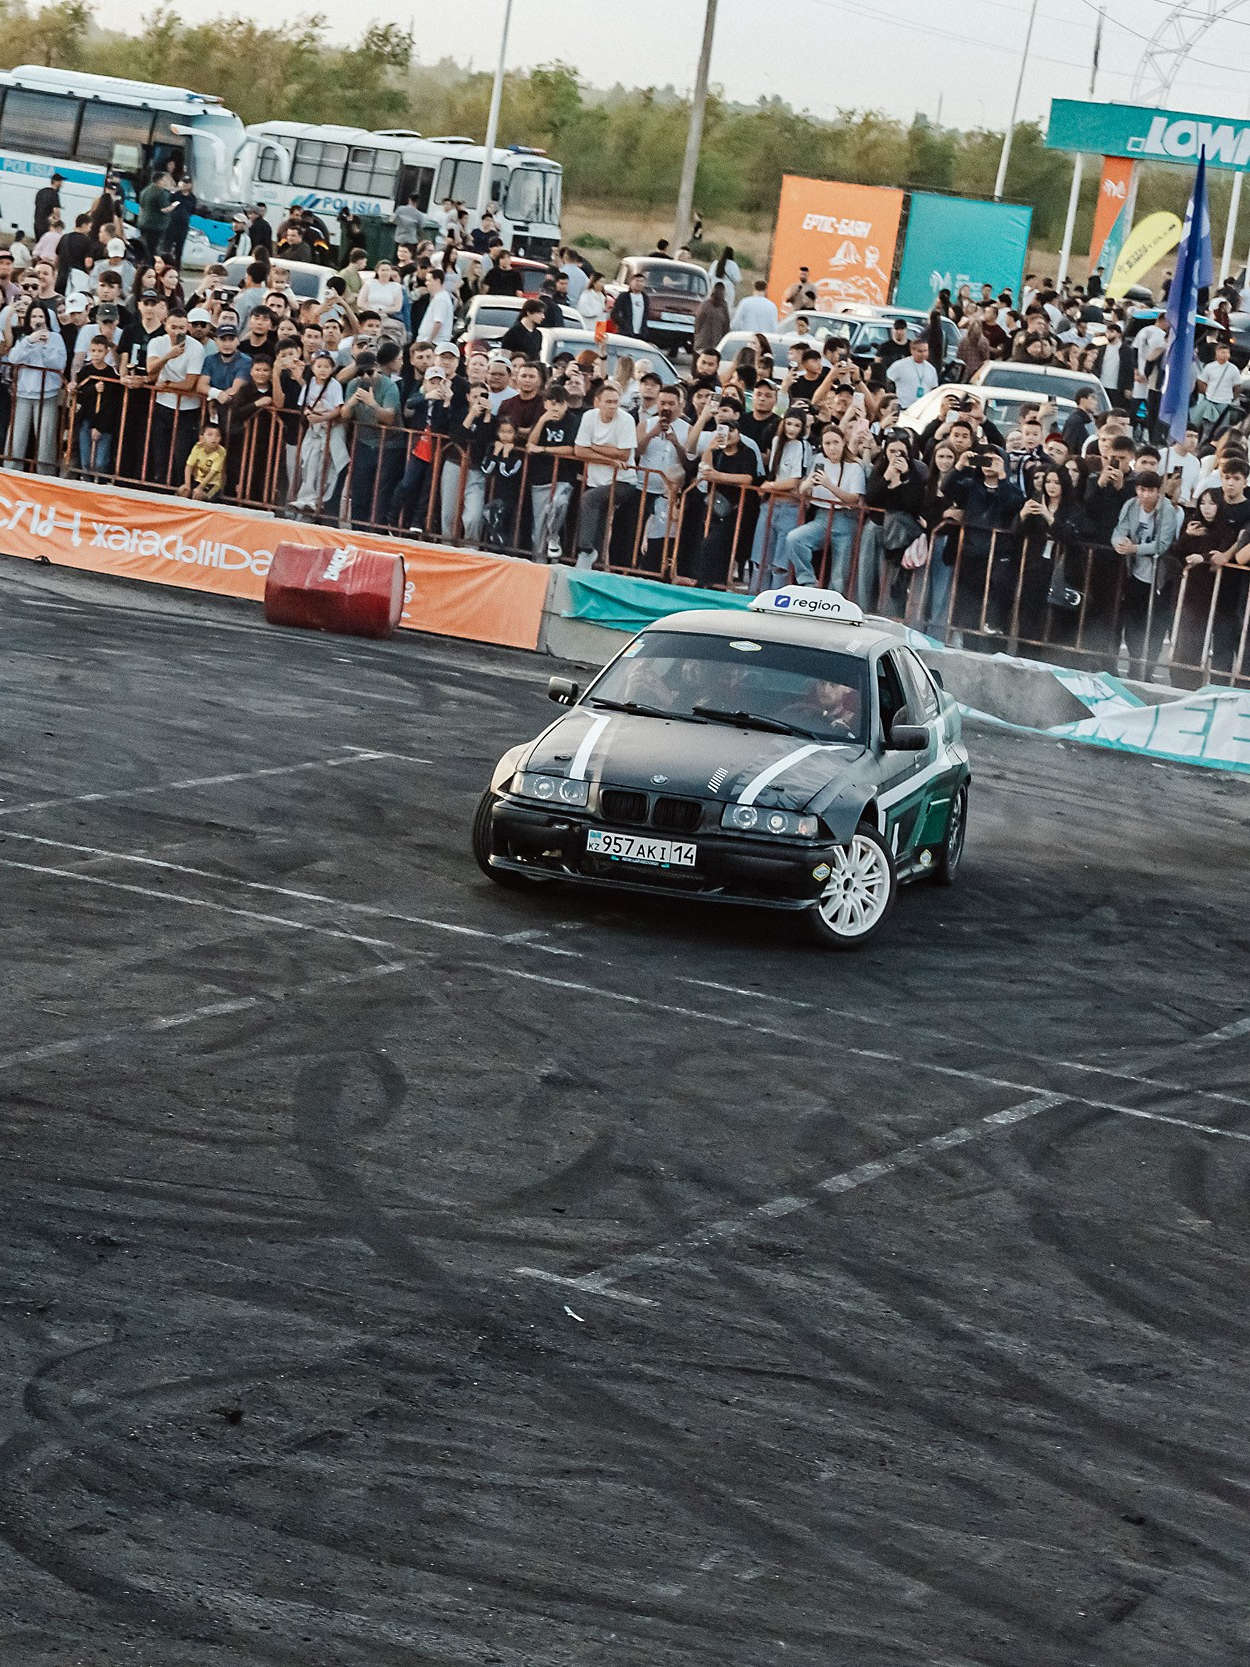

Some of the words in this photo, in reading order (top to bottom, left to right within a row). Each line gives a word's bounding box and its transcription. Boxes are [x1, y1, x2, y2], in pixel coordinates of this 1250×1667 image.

[323, 196, 382, 215] POLISIA
[792, 598, 841, 613] region
[588, 842, 600, 851] KZ
[602, 835, 635, 856] 957
[636, 844, 667, 861] AKI
[673, 845, 695, 864] 14
